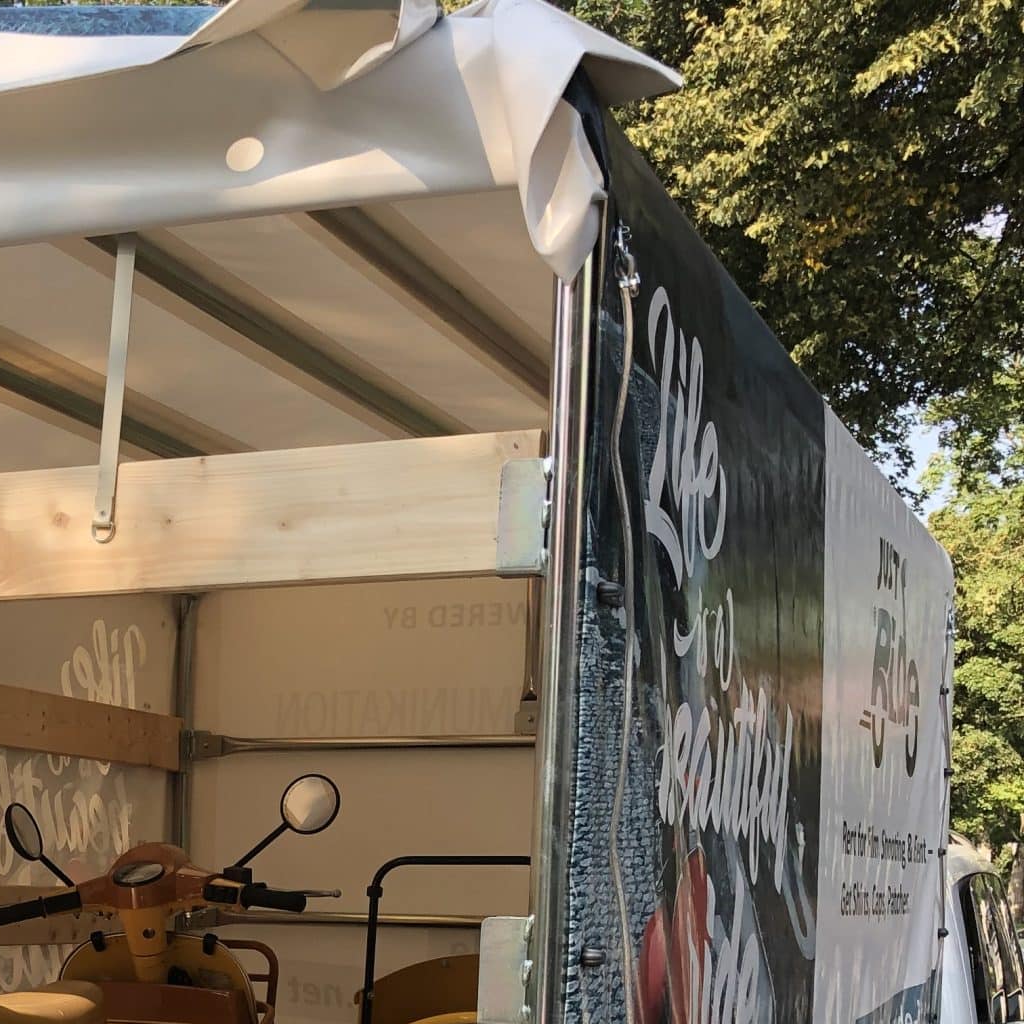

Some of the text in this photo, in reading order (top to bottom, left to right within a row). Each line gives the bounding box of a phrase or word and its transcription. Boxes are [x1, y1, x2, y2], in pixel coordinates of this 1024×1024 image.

[644, 286, 727, 592] Life
[876, 536, 900, 600] JUST
[657, 640, 794, 895] beautiful
